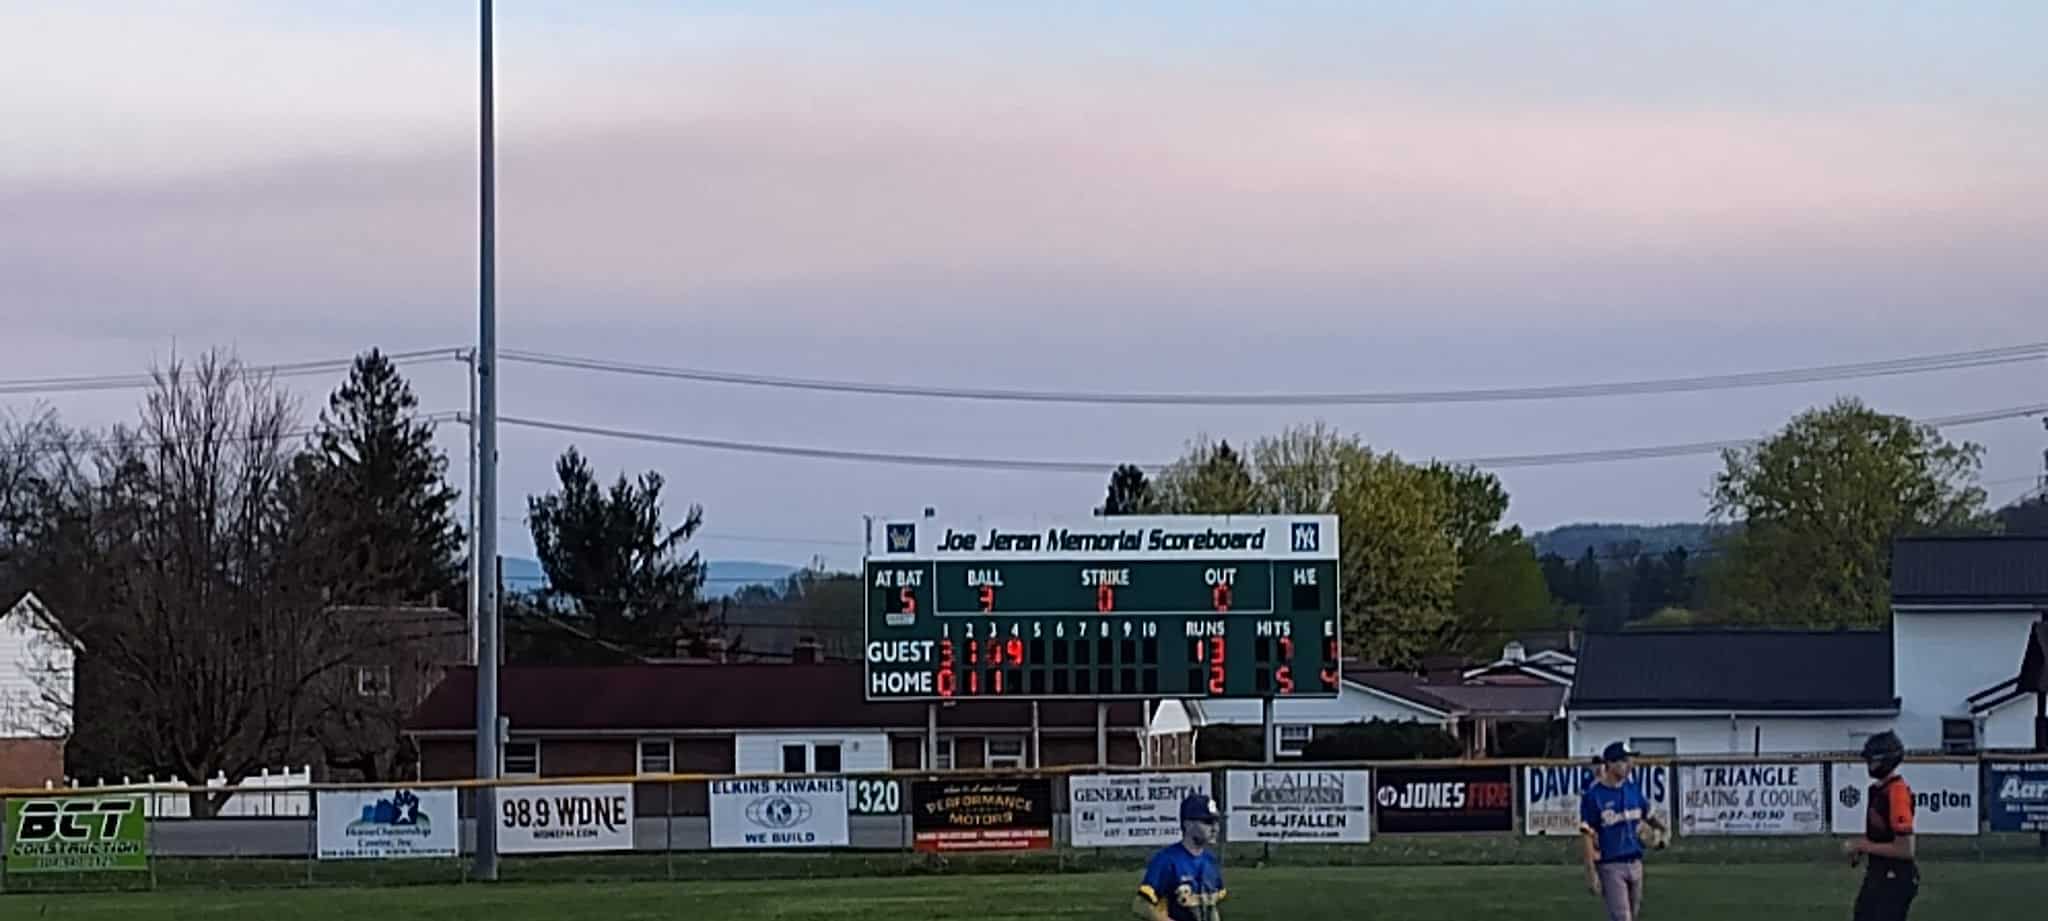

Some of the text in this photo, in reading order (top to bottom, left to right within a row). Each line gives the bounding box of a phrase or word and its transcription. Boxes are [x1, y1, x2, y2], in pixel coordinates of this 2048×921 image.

[938, 529, 1265, 551] Joe Jeran Memorial Scoreboard
[875, 570, 923, 587] AT BAT
[967, 570, 1004, 586] BALL
[1081, 569, 1130, 586] STRIKE
[1204, 568, 1236, 585] OUT
[901, 586, 917, 614] 5
[979, 585, 995, 614] 3
[1097, 584, 1114, 613] 0
[1213, 583, 1232, 613] 0
[942, 621, 1157, 638] 1 2 3 4 5 6 7 8 9 10
[1186, 621, 1225, 636] RUNS
[1257, 620, 1291, 636] HITS
[1324, 620, 1334, 636] E
[868, 640, 934, 663] GUEST
[1006, 639, 1024, 666] 9
[1196, 637, 1225, 664] 13
[872, 672, 932, 693] HOME
[937, 669, 956, 697] 0
[970, 670, 978, 693] 1
[994, 669, 1003, 693] 1
[1208, 666, 1225, 694] 2
[1275, 665, 1295, 694] 5
[712, 780, 845, 794] ELKINS KIWANIS
[1704, 766, 1799, 787] TRIANGLE
[925, 795, 1033, 814] PERFORMANCE
[1074, 787, 1144, 802] GENERAL
[1399, 782, 1466, 809] JONES
[1467, 783, 1511, 808] FIRE
[1685, 788, 1819, 808] HEATING & COOLING
[16, 799, 135, 842] BCT
[502, 796, 628, 833] 98.9 WDNE
[948, 811, 1013, 825] MOTORS
[1249, 813, 1346, 828] 844-JFALLEN
[745, 832, 815, 844] WE BUILD
